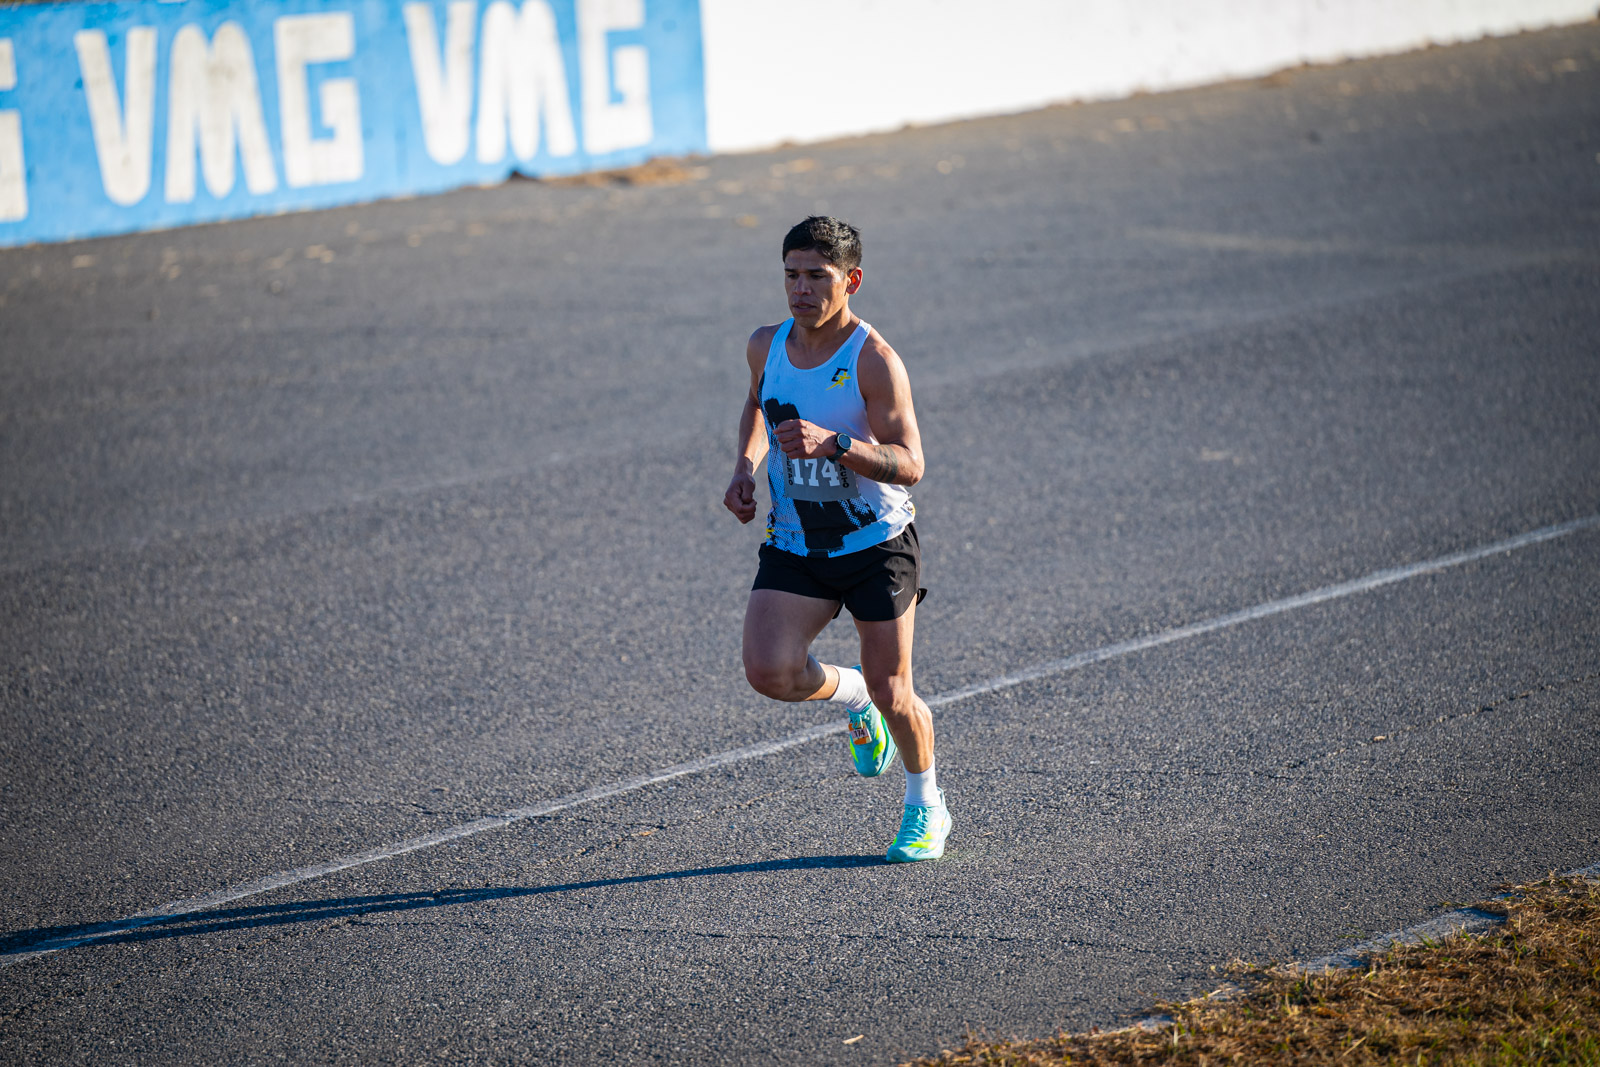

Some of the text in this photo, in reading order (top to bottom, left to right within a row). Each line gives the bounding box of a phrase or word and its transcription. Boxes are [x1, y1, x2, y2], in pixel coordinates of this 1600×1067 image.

[74, 12, 365, 206] VMG
[403, 0, 655, 166] VMG
[791, 458, 840, 487] 174
